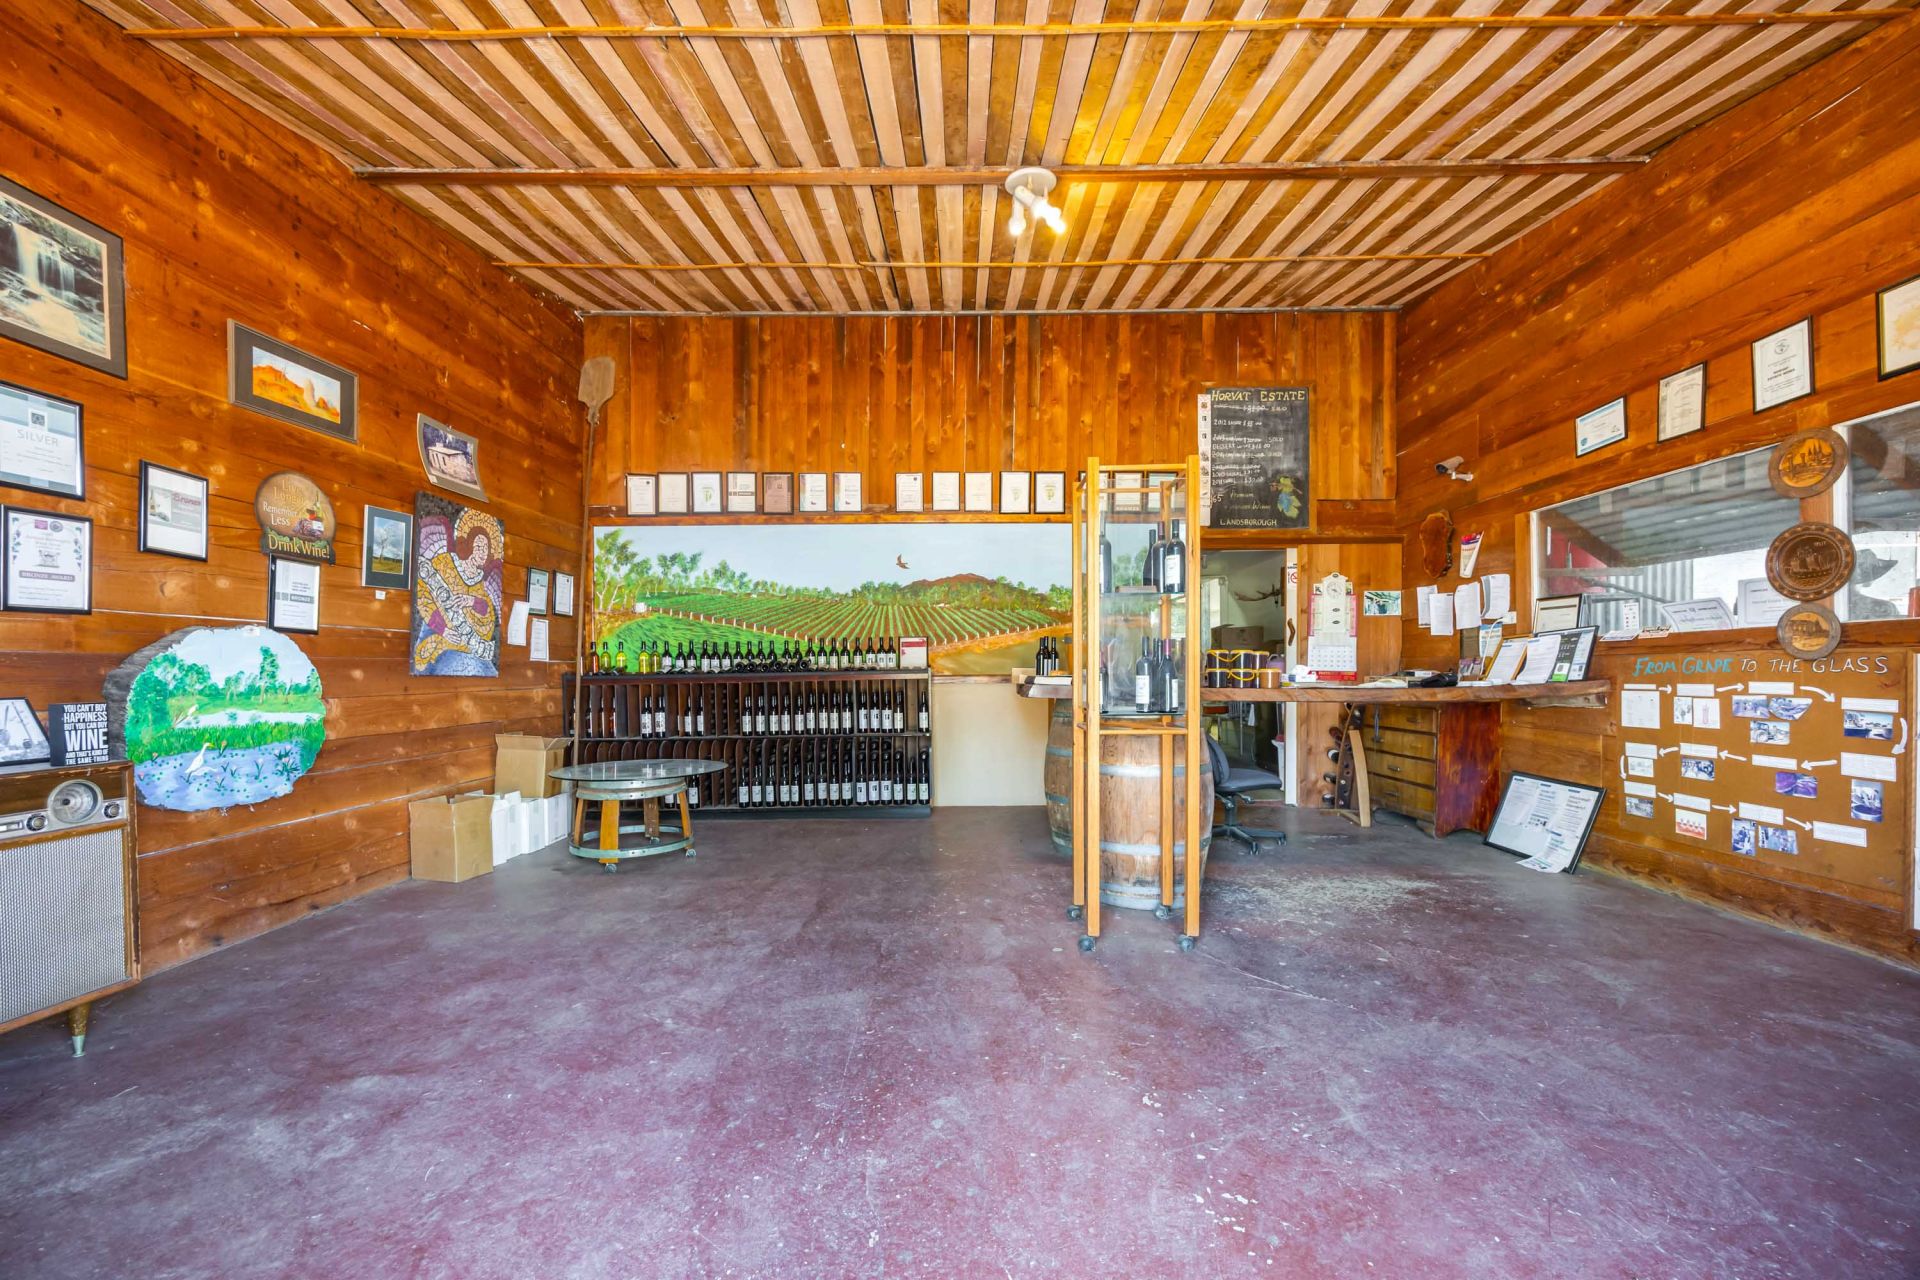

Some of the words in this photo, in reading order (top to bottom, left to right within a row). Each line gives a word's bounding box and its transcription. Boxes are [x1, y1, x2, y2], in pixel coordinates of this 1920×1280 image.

[1211, 390, 1252, 401] HORVAT
[1260, 390, 1306, 402] ESTATE
[16, 428, 59, 447] SILVER
[263, 500, 298, 517] Remember
[271, 512, 291, 526] Less
[1219, 518, 1278, 526] LANDSBOROUGH
[267, 534, 301, 555] Drink
[301, 541, 330, 559] Wine!
[1632, 656, 1677, 677] FROM
[1682, 656, 1734, 675] GRAPE
[1740, 658, 1758, 673] TO
[1768, 658, 1802, 673] THE
[1812, 656, 1889, 675] GLASS
[63, 704, 77, 712] YOU
[77, 704, 95, 712] CAN'T
[95, 703, 107, 712] BUY
[63, 711, 107, 723] HAPPINESS
[75, 722, 86, 730] YOU
[97, 721, 108, 729] BUY
[64, 728, 109, 752] WINE
